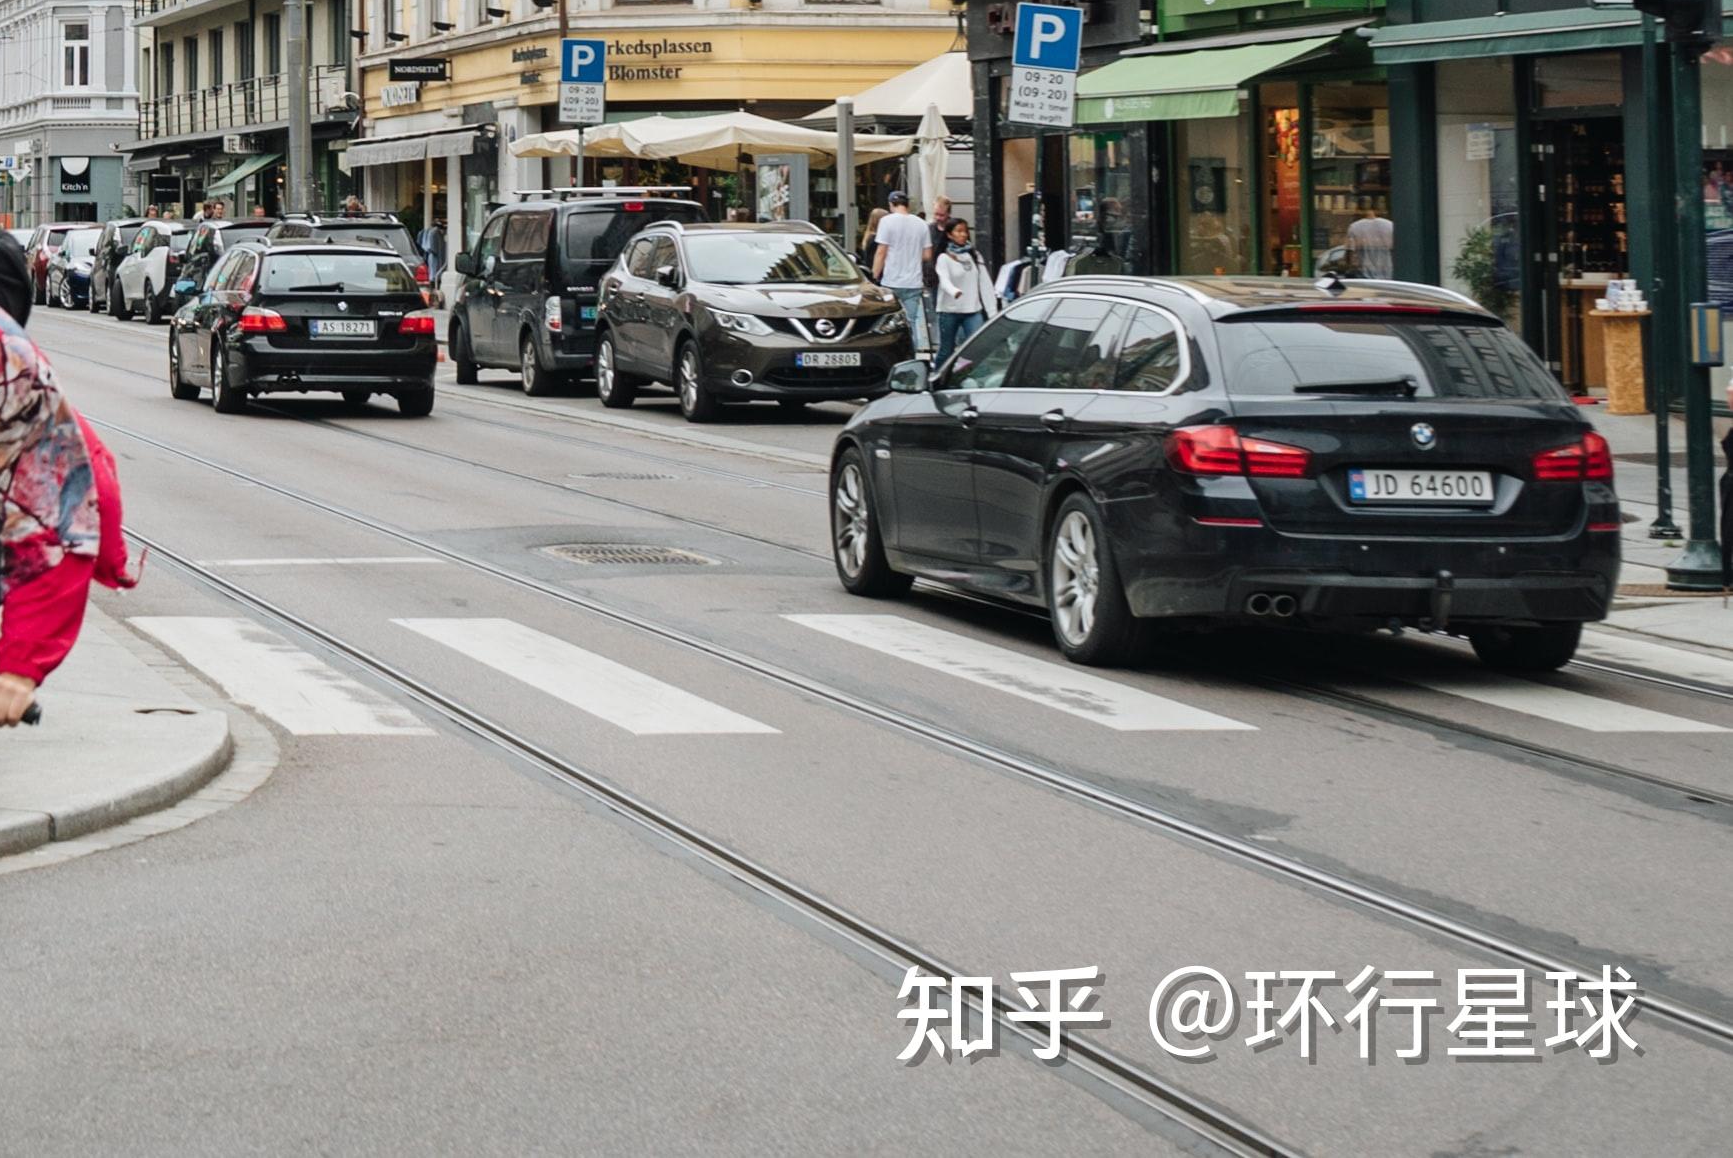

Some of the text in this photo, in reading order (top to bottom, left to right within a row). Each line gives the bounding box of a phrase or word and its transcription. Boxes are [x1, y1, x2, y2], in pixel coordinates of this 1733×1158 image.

[1029, 13, 1066, 59] P
[571, 45, 595, 78] P
[609, 64, 682, 81] Blomster
[340, 322, 370, 332] 18271
[1373, 474, 1483, 497] JD 64600
